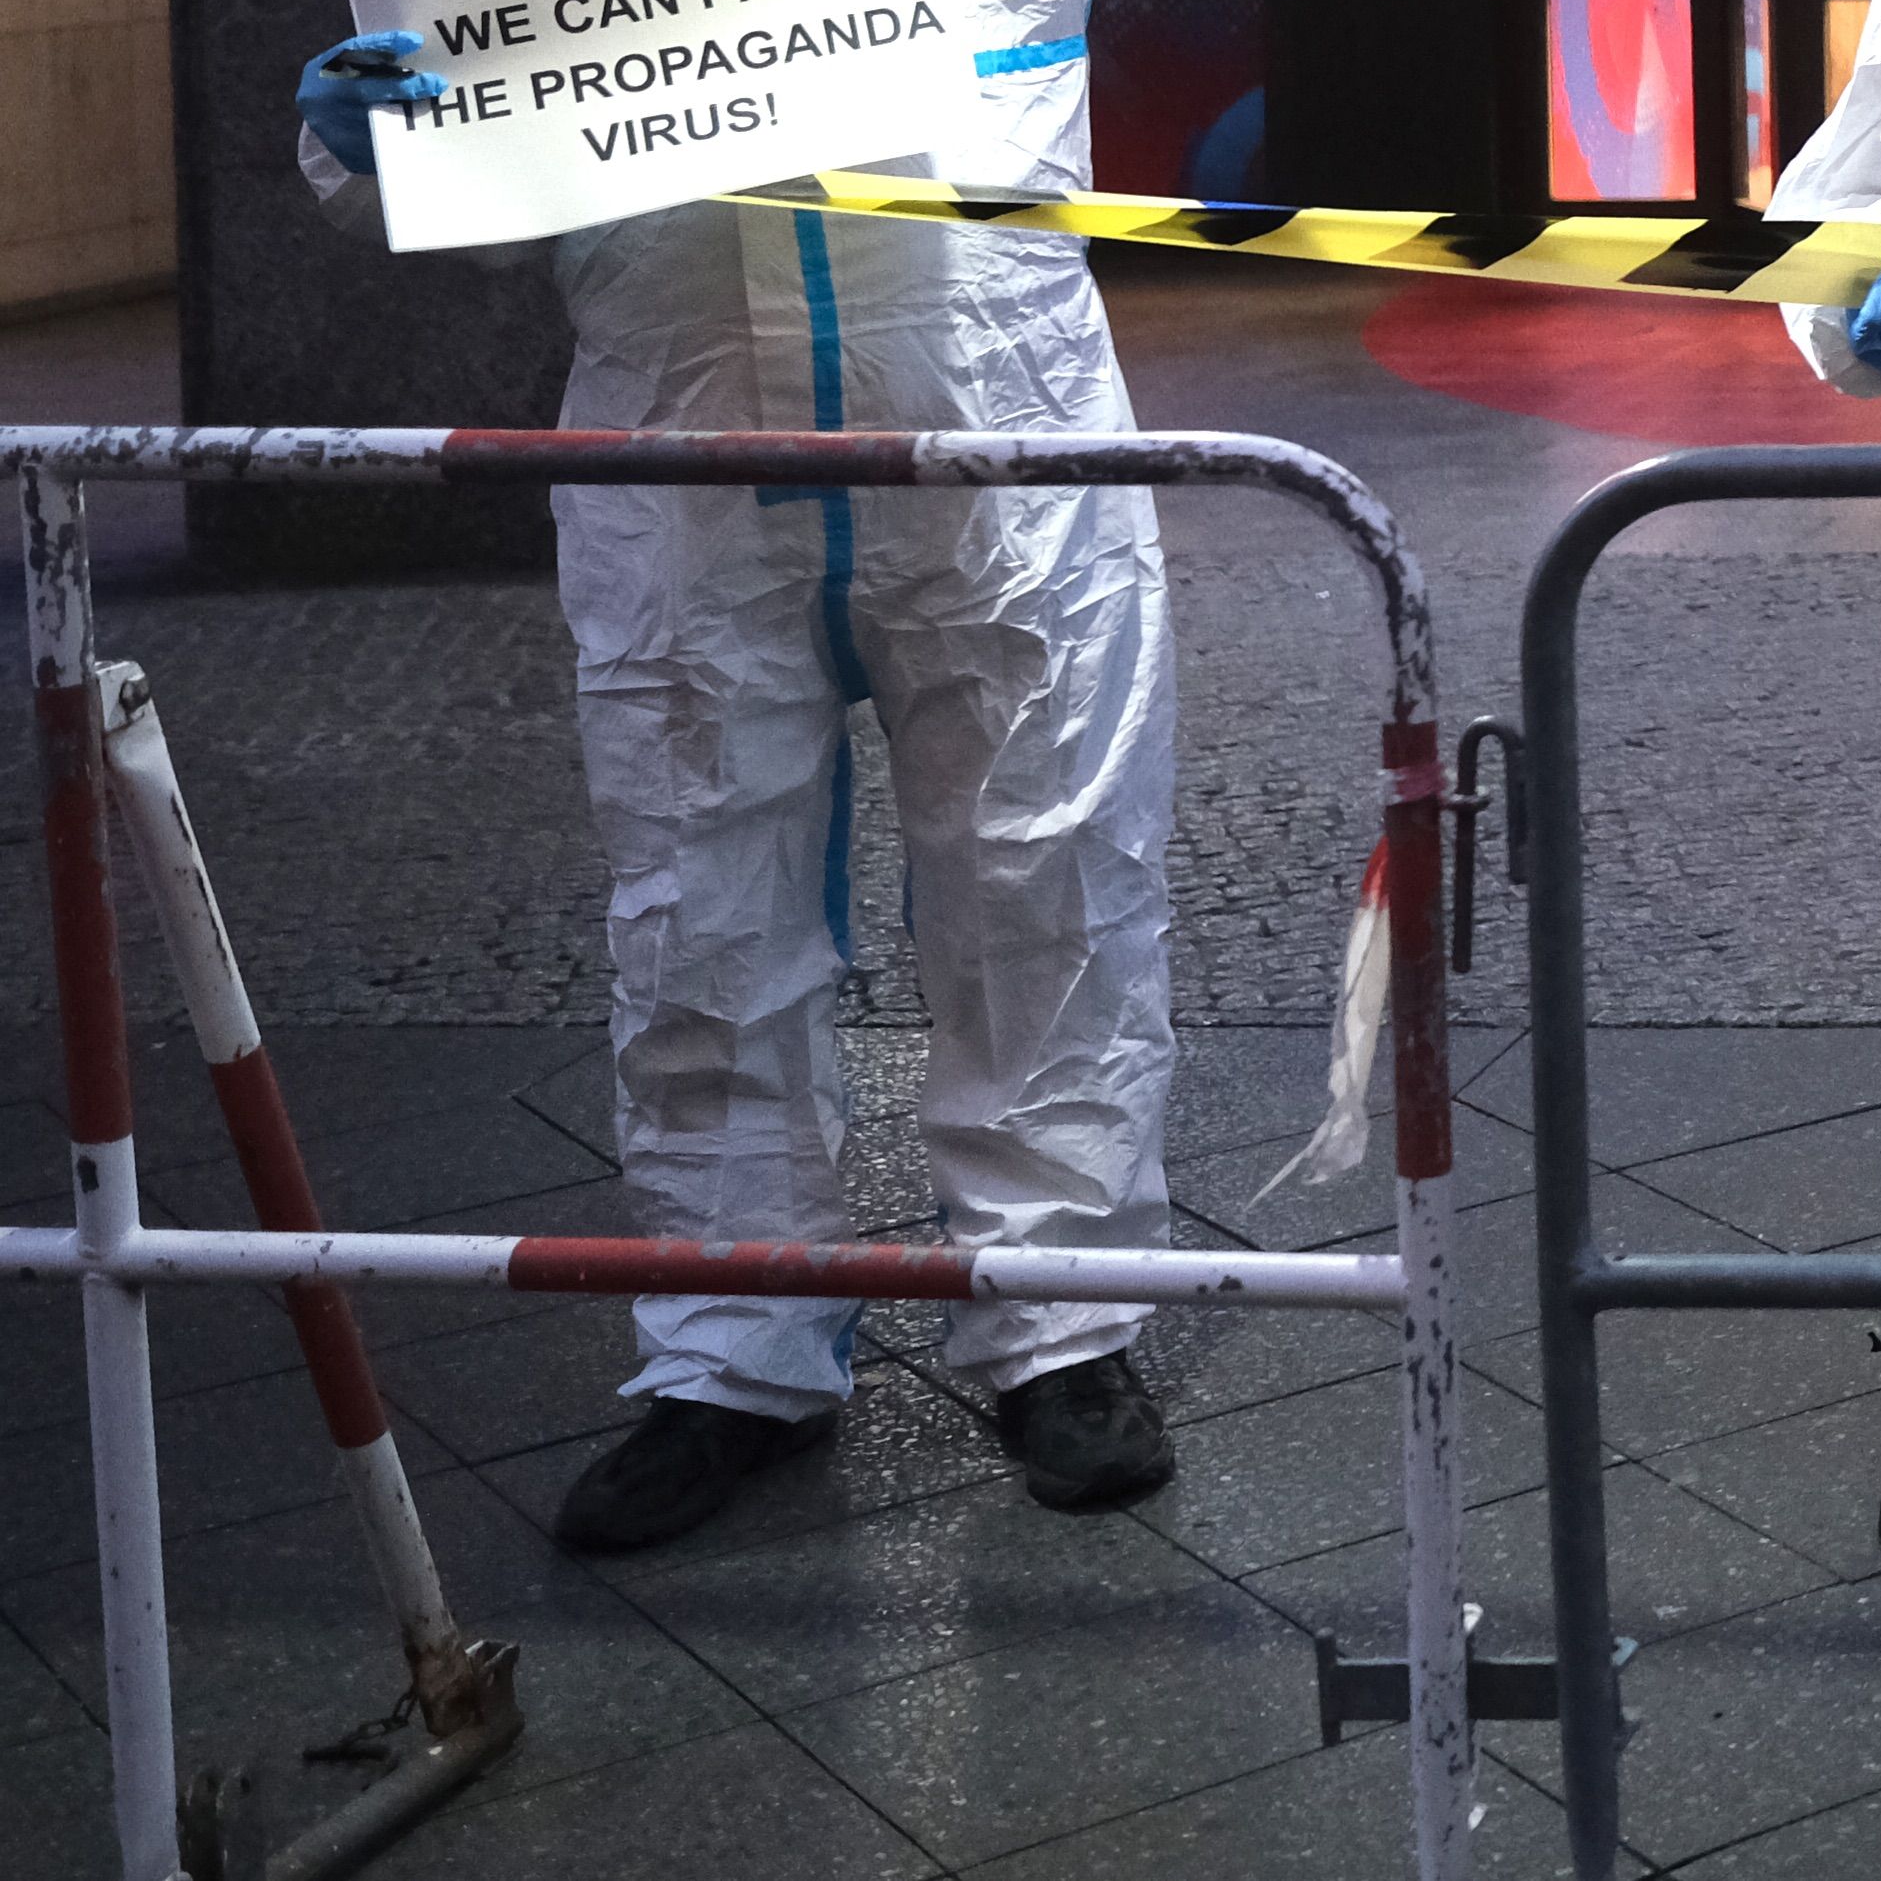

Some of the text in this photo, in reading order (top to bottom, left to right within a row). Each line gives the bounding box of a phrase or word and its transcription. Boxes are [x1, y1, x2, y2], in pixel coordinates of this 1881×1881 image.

[434, 2, 537, 58] WE
[530, 0, 946, 111] PROPAGANDA
[580, 92, 780, 163] VIRUS!
